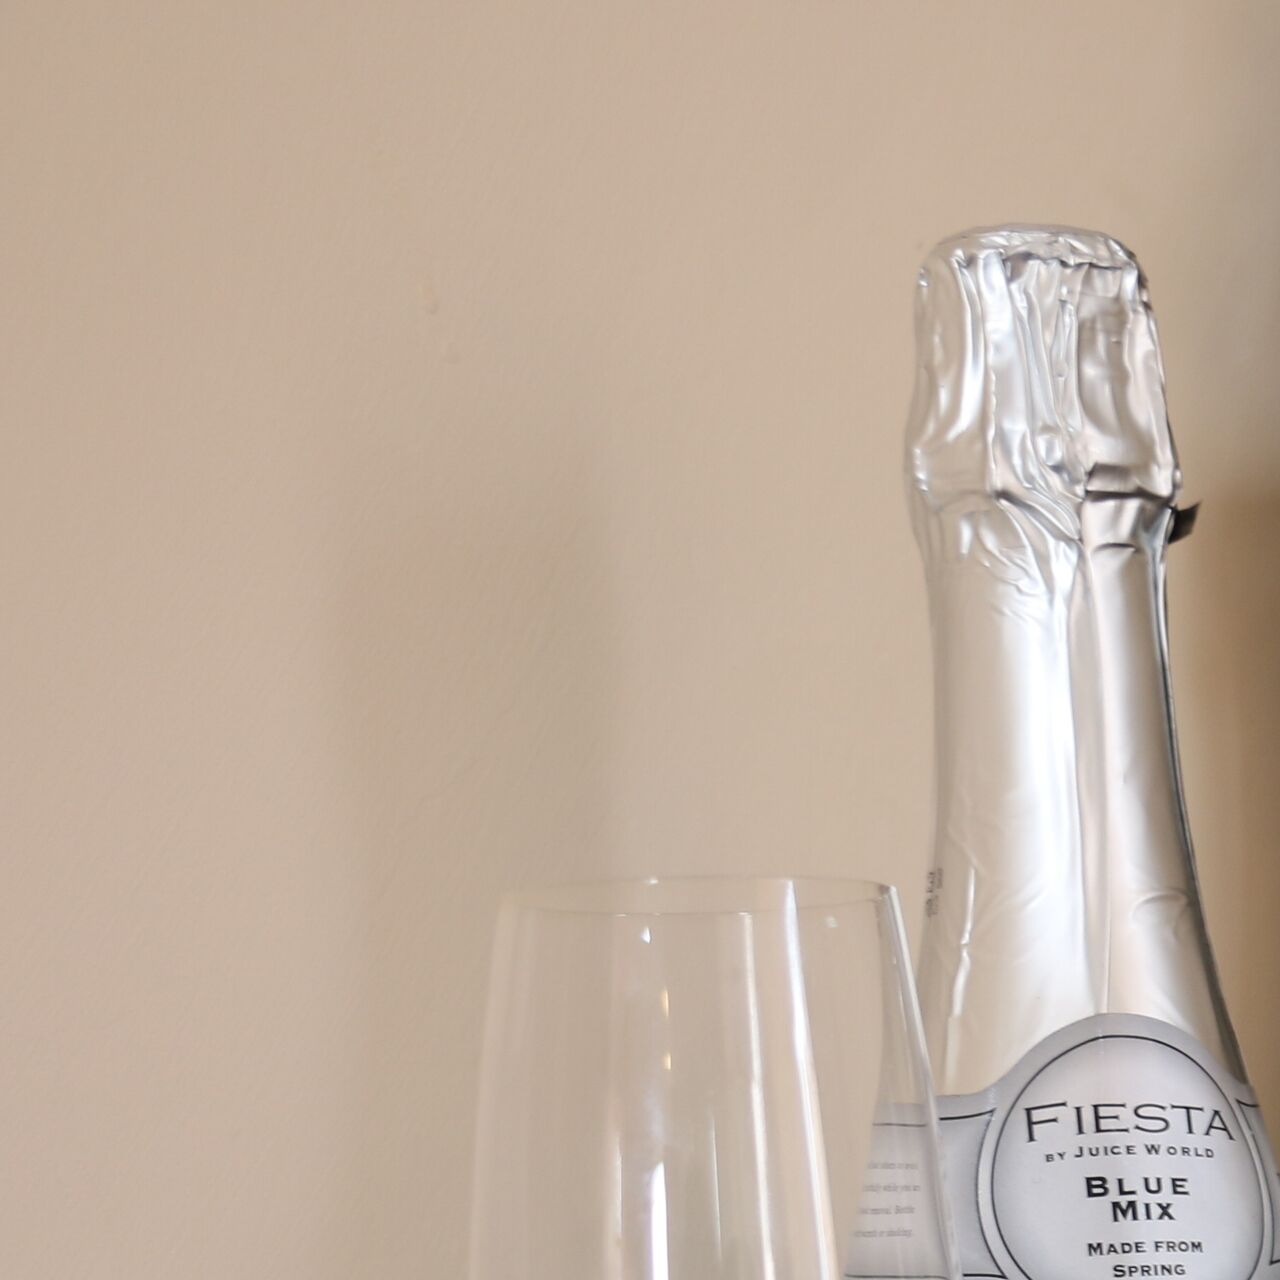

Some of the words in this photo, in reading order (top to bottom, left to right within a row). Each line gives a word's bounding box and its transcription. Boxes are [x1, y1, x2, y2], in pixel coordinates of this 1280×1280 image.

[1024, 1101, 1237, 1143] FIESTA
[1045, 1152, 1067, 1163] BY
[1074, 1145, 1137, 1159] JUICE
[1143, 1143, 1215, 1159] WORLD
[1085, 1175, 1190, 1198] BLUE
[1111, 1200, 1176, 1222] MIX
[1087, 1241, 1147, 1257] MADE
[1154, 1241, 1204, 1254] FROM
[1112, 1264, 1187, 1278] SPRING
